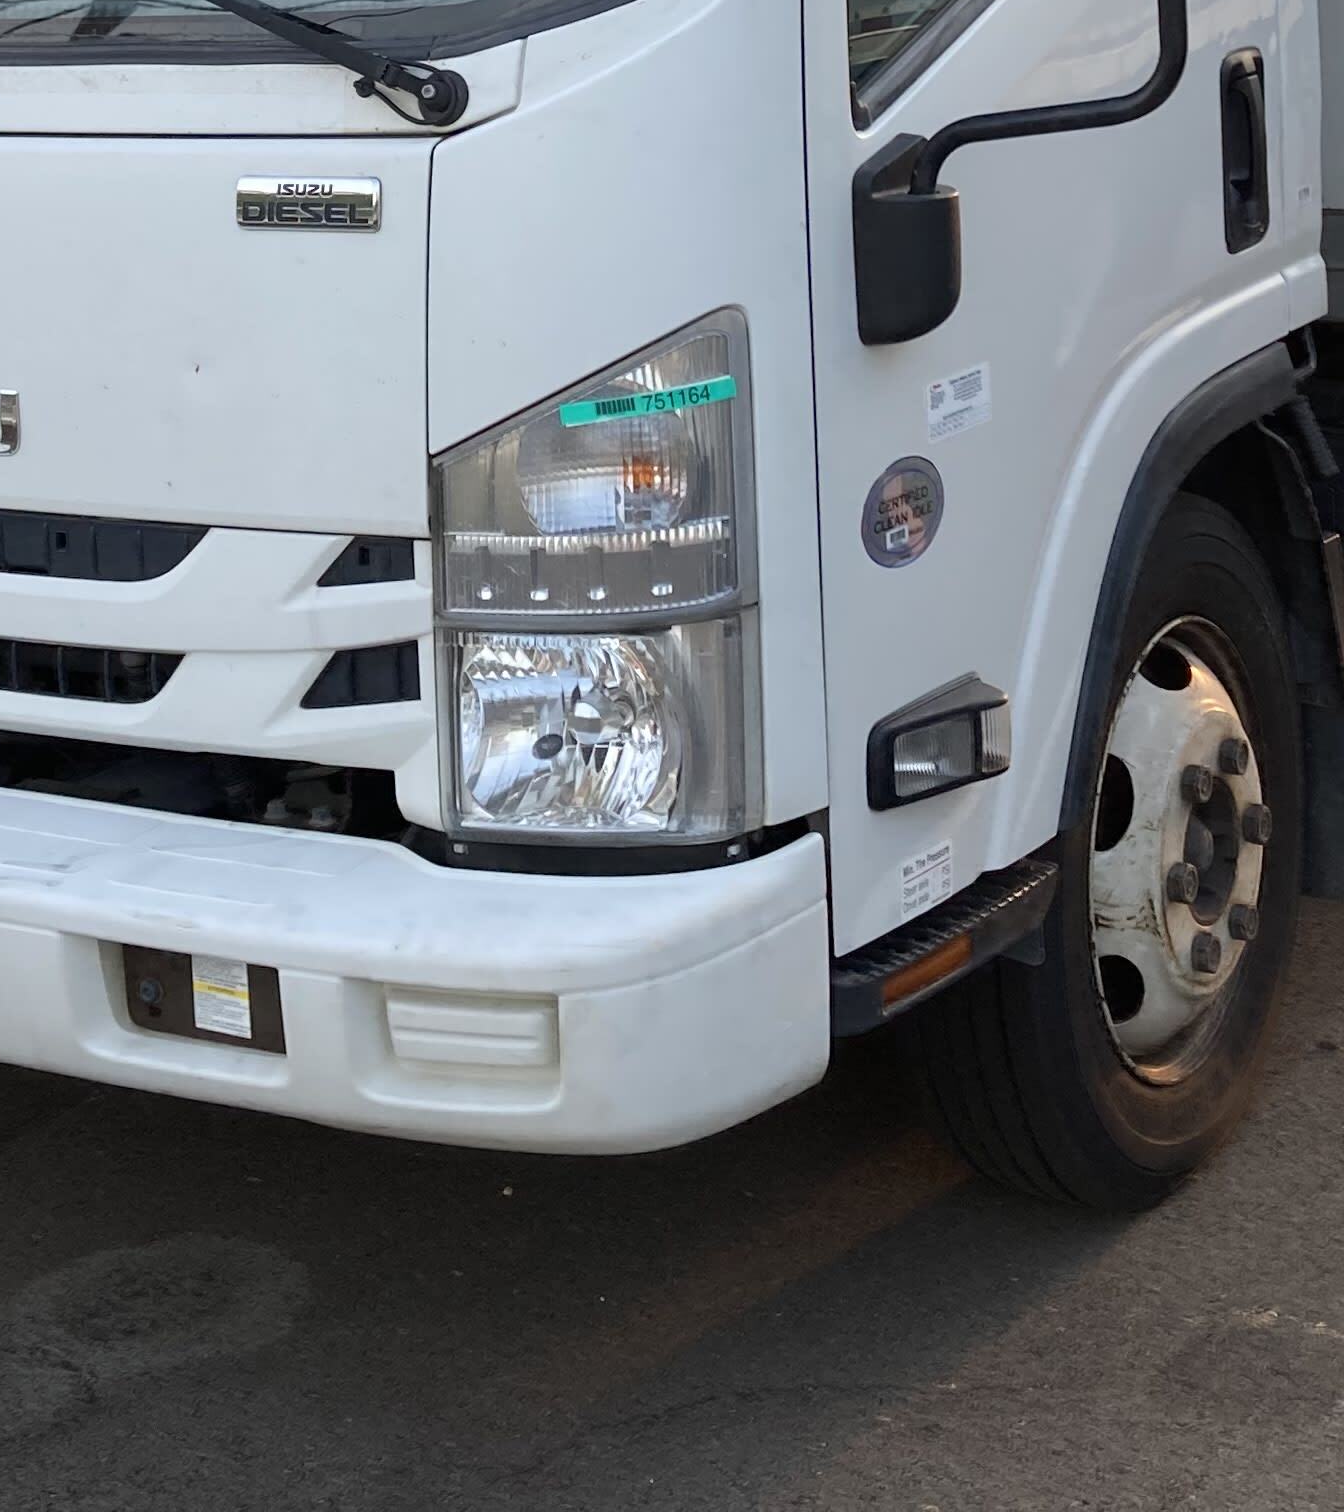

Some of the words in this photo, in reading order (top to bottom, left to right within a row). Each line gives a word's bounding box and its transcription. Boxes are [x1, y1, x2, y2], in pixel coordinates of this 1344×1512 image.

[277, 183, 333, 196] ISUZU
[242, 201, 369, 224] DIESEL
[641, 385, 710, 412] 751164
